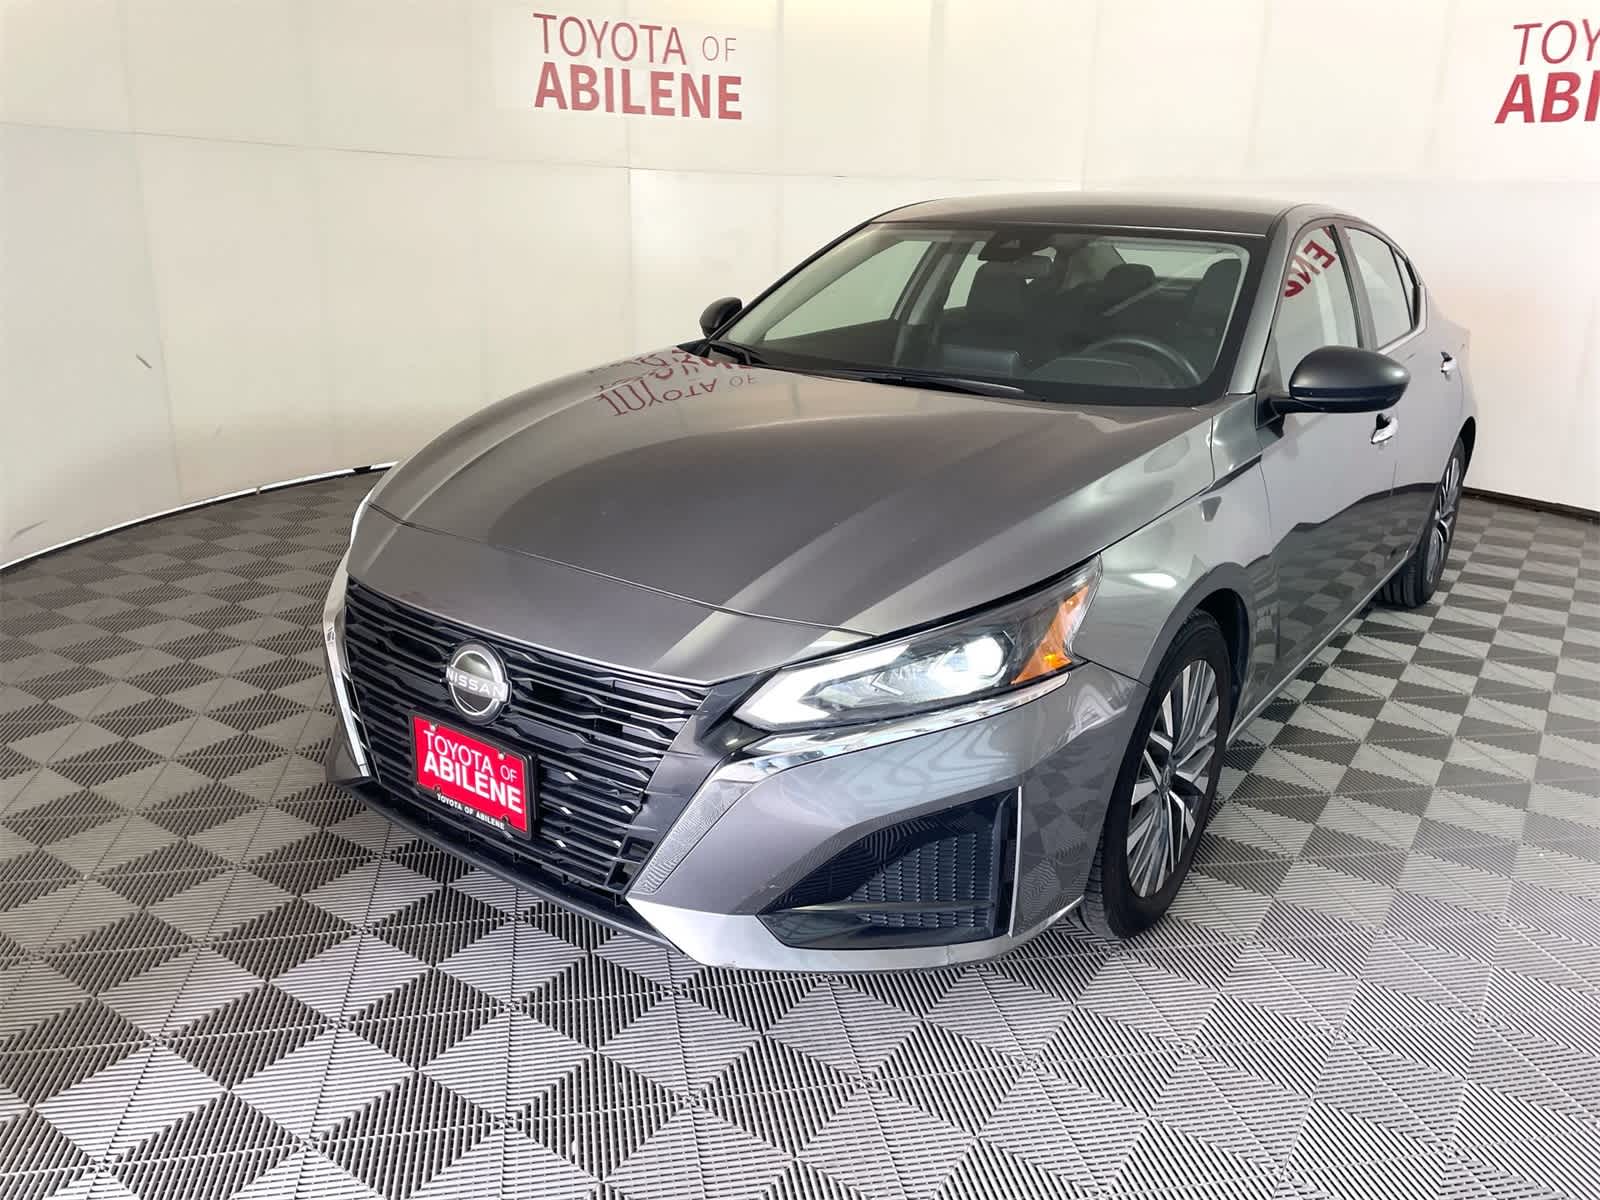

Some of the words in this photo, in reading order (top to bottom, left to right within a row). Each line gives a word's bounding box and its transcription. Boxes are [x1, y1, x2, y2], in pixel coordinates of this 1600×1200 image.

[533, 13, 687, 65] TOYOTA
[702, 36, 737, 62] OF
[534, 61, 742, 120] ABILENE
[446, 667, 507, 699] NISSAN
[424, 730, 494, 776] TOYOTA
[500, 765, 517, 783] OF
[424, 752, 522, 814] ABILENE
[437, 793, 463, 810] TOYOTA
[464, 806, 474, 815] OF
[475, 811, 505, 830] ABILENE
